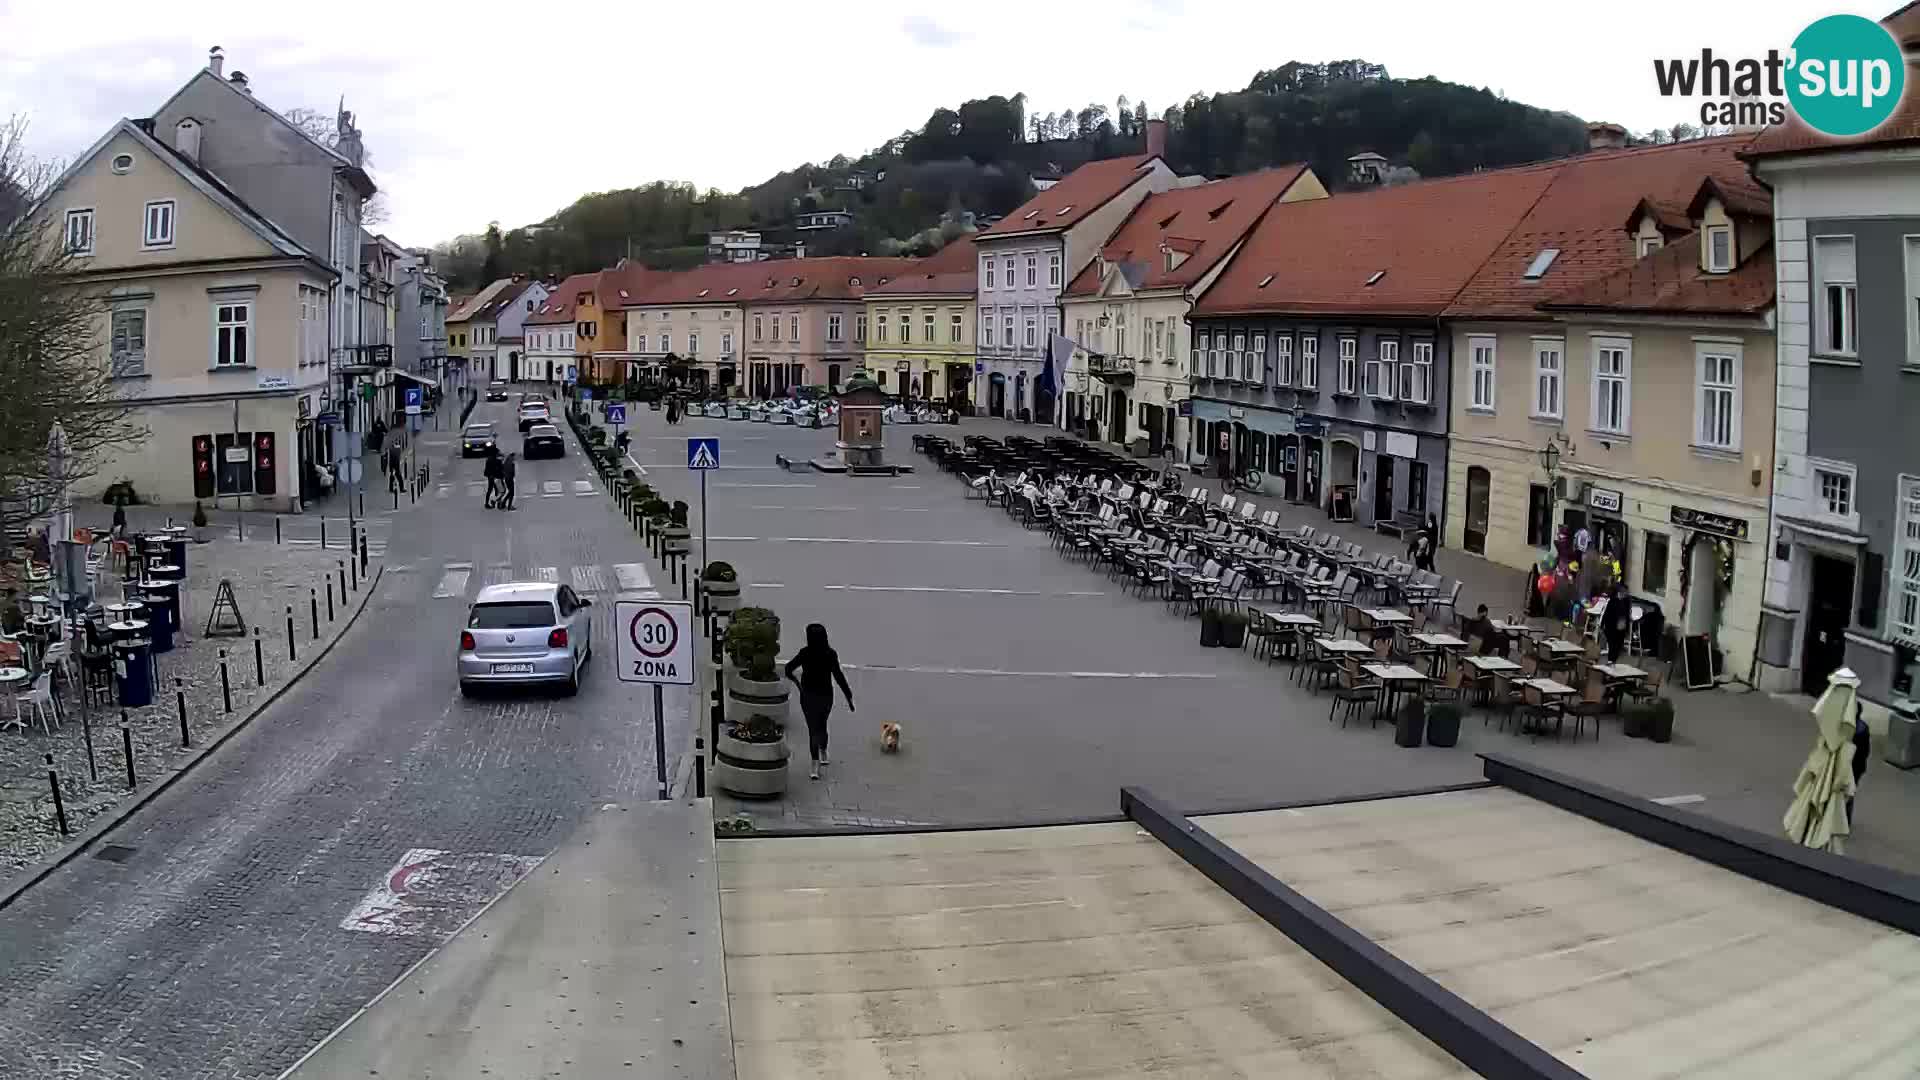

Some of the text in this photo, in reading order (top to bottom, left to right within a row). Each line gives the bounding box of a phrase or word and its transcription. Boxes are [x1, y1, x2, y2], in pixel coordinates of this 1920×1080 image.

[409, 392, 417, 402] P
[643, 623, 667, 644] 30
[633, 660, 678, 677] ZONA
